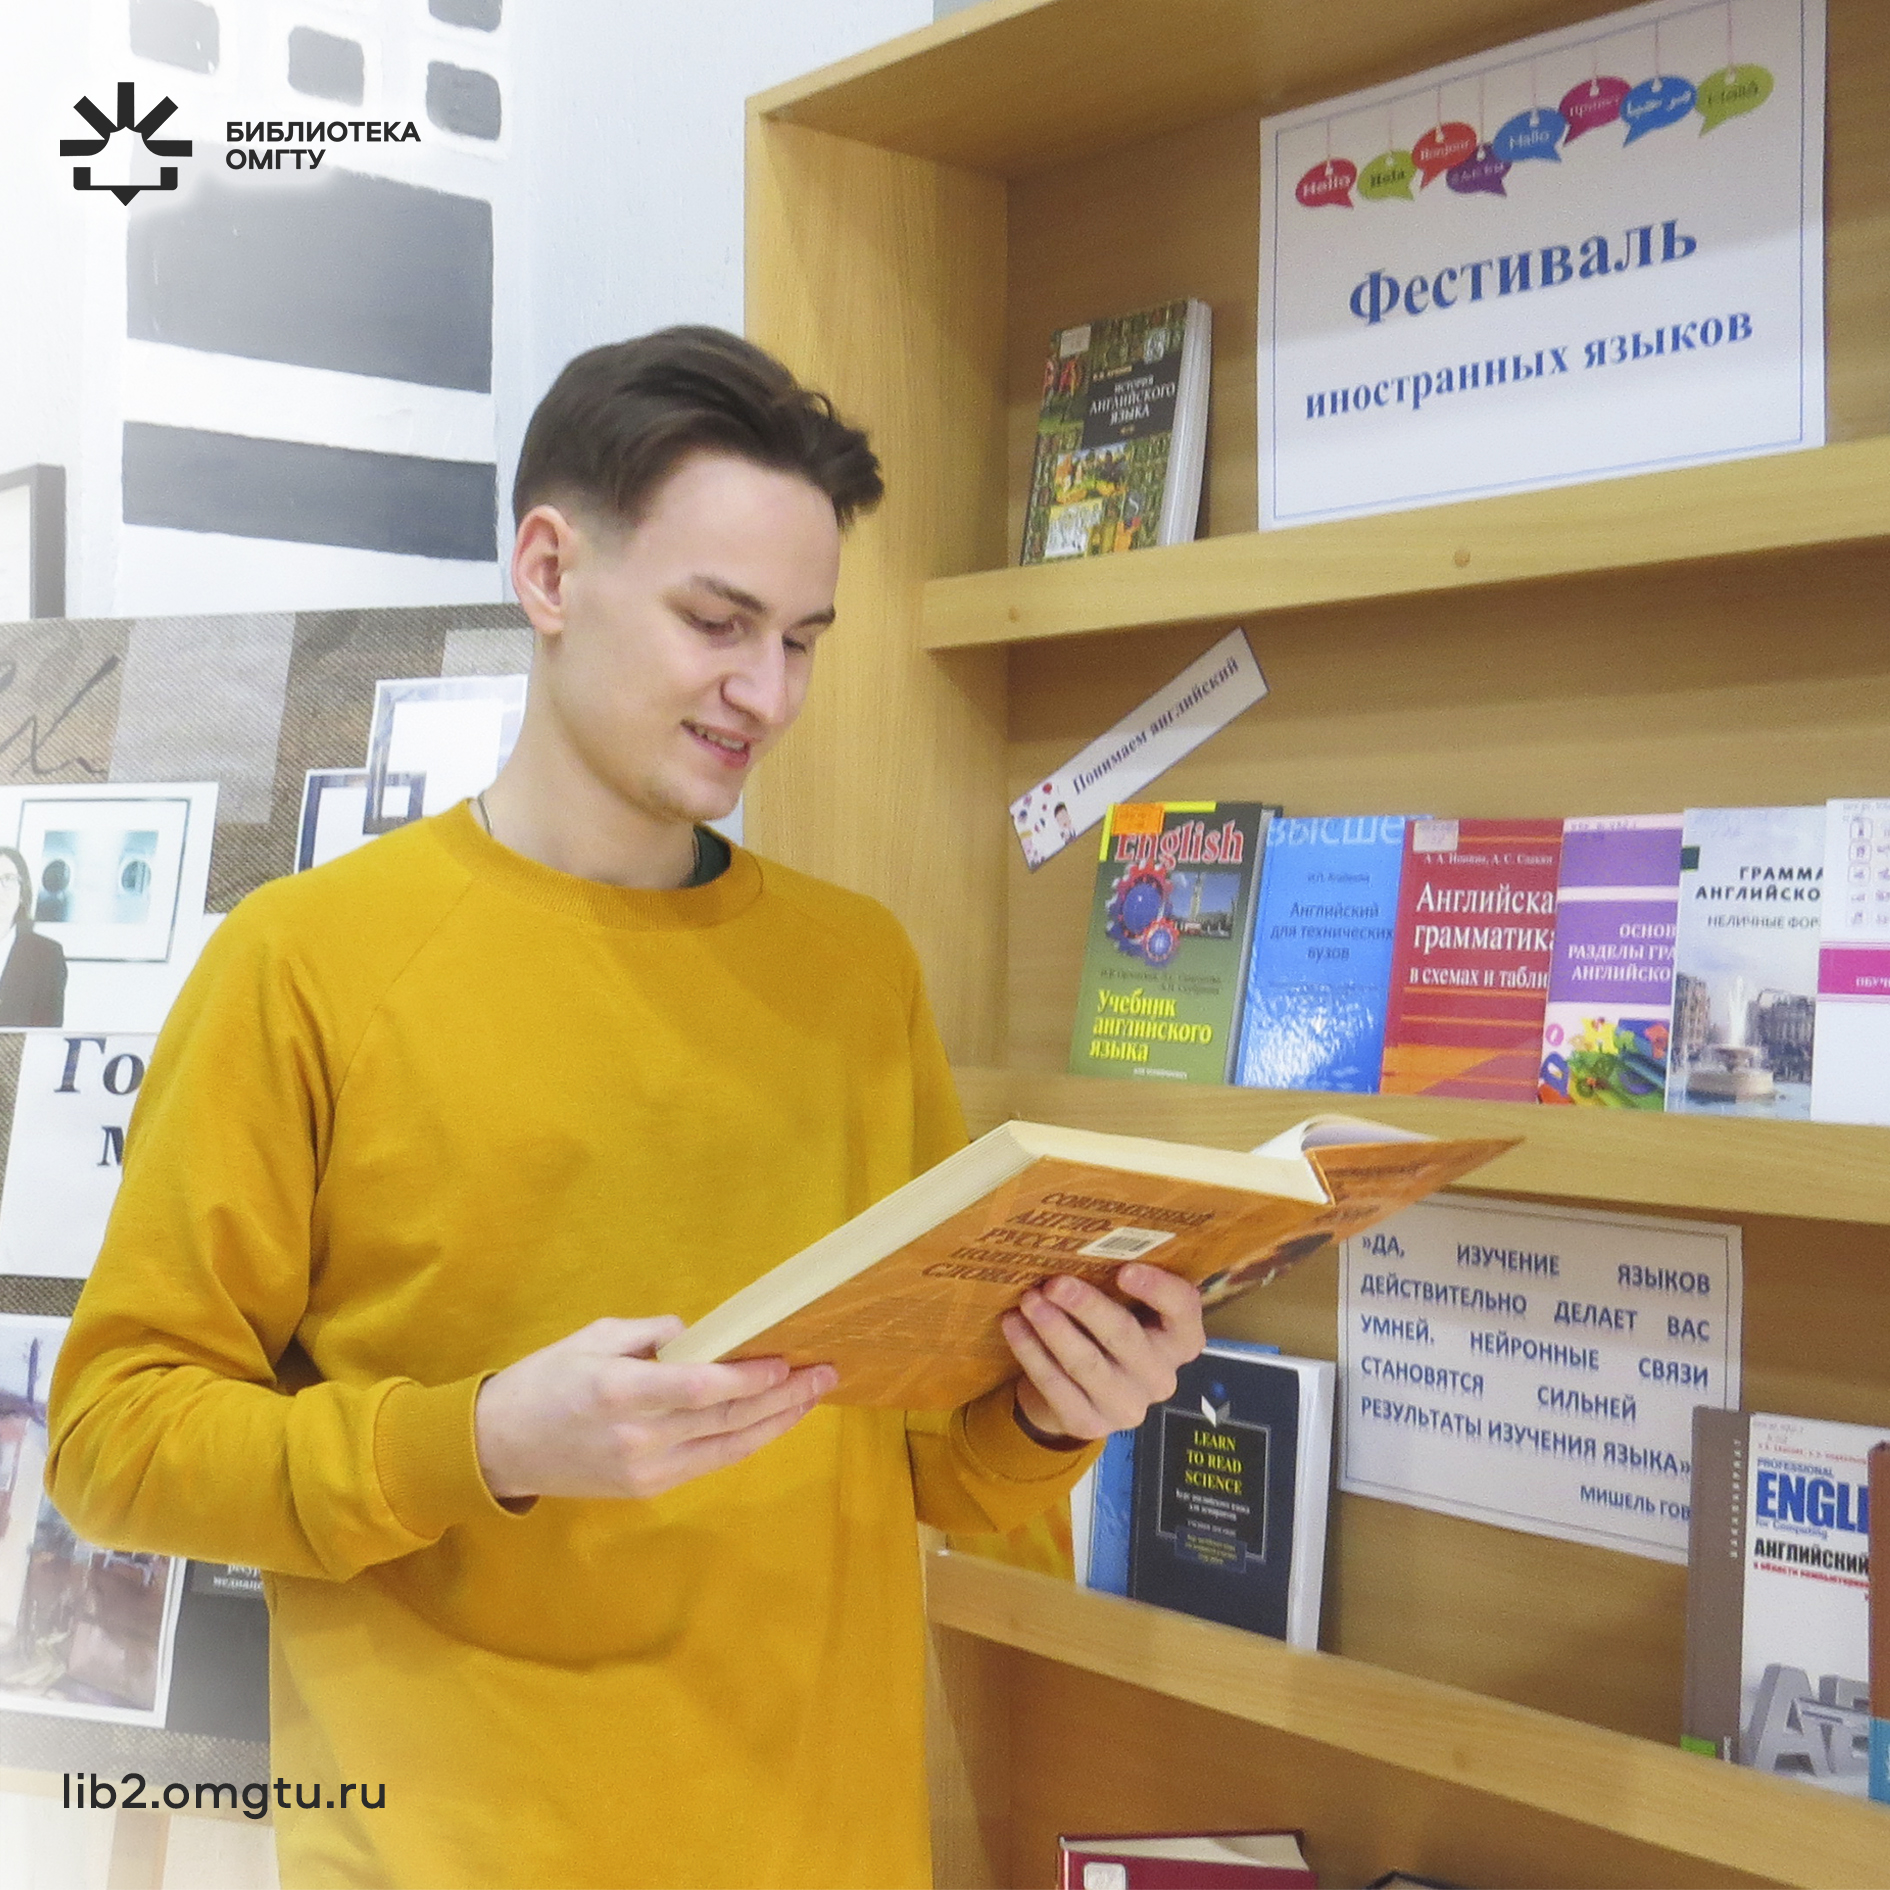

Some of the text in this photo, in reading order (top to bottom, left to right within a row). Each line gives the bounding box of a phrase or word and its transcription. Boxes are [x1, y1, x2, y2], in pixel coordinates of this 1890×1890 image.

[1303, 175, 1351, 197] Hello
[1349, 218, 1698, 326] Фестиваль
[1305, 311, 1754, 420] иностранных языков
[1072, 656, 1239, 794] Понимаем английский
[1114, 819, 1244, 871] English
[1696, 884, 1821, 901] АНГЛИЙСКО
[1290, 901, 1379, 919] Английский
[1708, 915, 1785, 929] НЕЛИЧНЫЕ
[1270, 925, 1395, 940] для технических
[1307, 946, 1350, 963] вузов
[1568, 944, 1645, 962] РАЗДЕЛЫ
[1409, 968, 1419, 985] в
[1422, 968, 1479, 987] схемах
[1483, 970, 1495, 987] и
[1571, 963, 1671, 981] АНГЛИЙСКО
[1098, 987, 1177, 1018] Учебник
[1090, 1039, 1149, 1062] языка
[53, 1037, 145, 1095] Го
[1362, 1233, 1711, 1295] »ДА, ИЗУЧЕНИЕ ЯЗЫКОВ
[1361, 1273, 1711, 1342] ДЕЙСТВИТЕЛЬНО ДЕЛАЕТ ВАС
[1361, 1314, 1709, 1388] УМНЕЙ. НЕЙРОННЫЕ СВЯЗИ
[1361, 1355, 1637, 1421] СТАНОВЯТСЯ СИЛЬНЕЙ
[1193, 1430, 1237, 1451] LEARN
[1361, 1395, 1691, 1476] РЕЗУЛЬТАТЫ ИЗУЧЕНИЯ ЯЗЫКА»
[1186, 1448, 1243, 1474] TO READ
[1757, 1456, 1834, 1478] PROFESSIONAL
[1184, 1469, 1243, 1495] SCIENCE
[1580, 1485, 1655, 1514] МИШЕЛЬ
